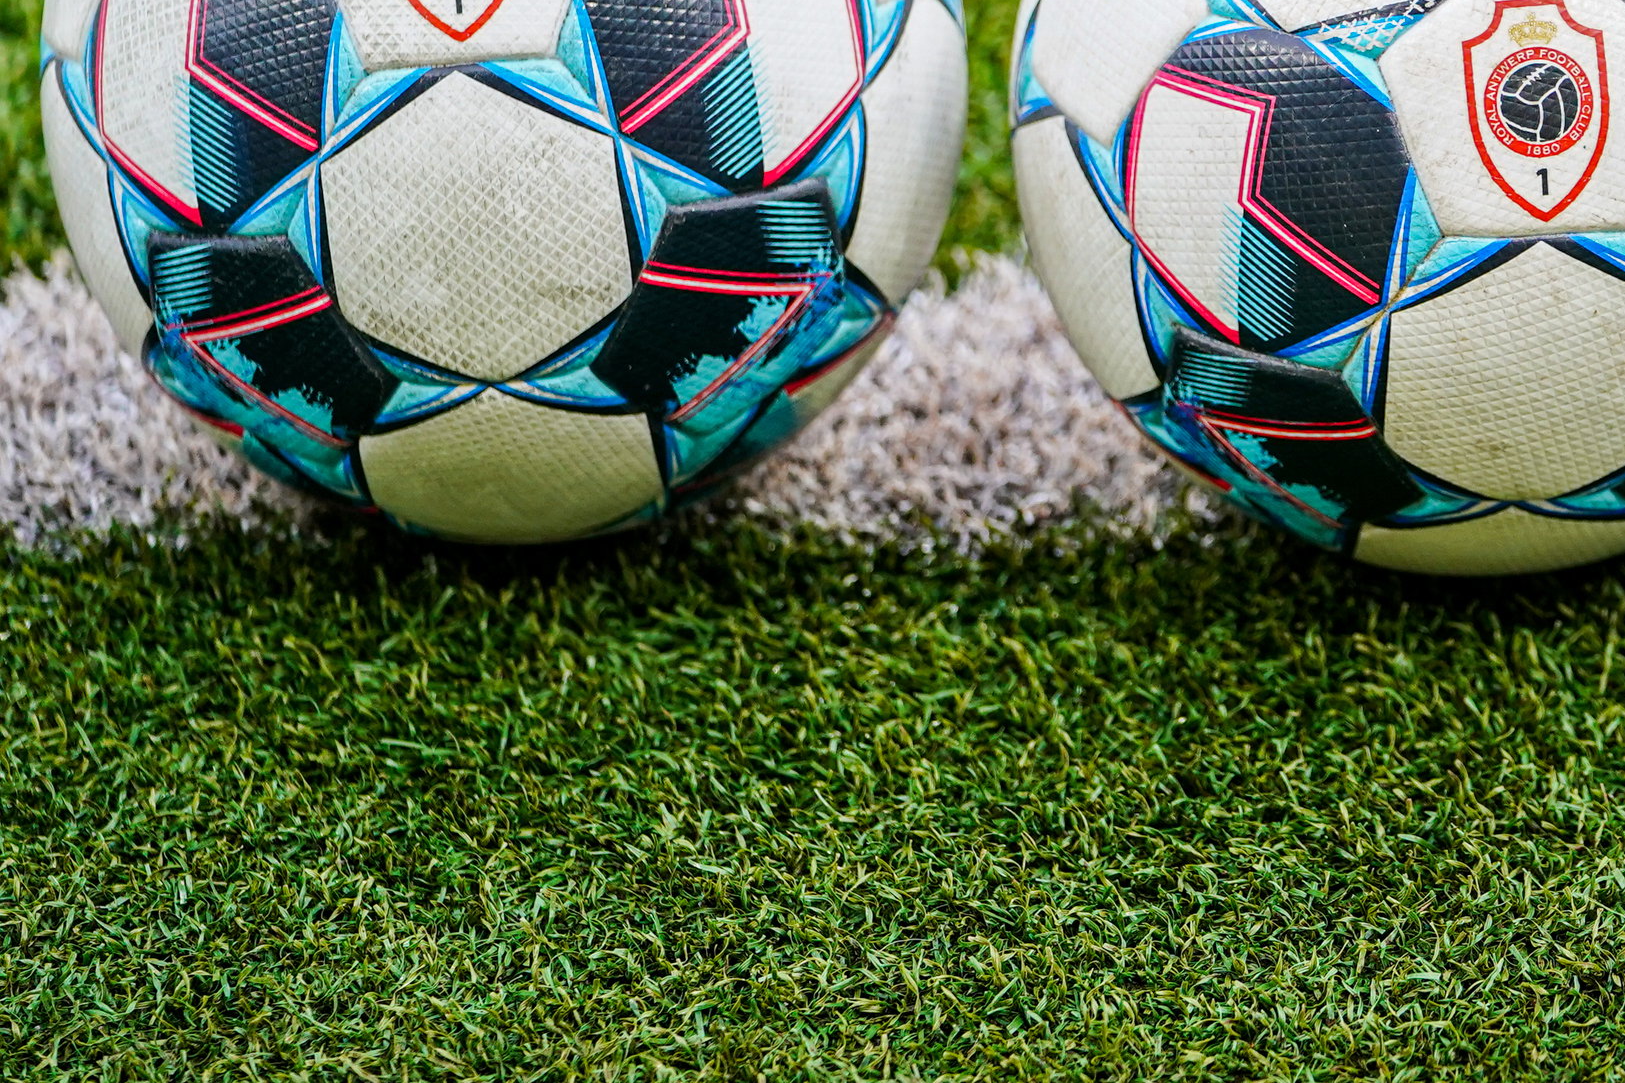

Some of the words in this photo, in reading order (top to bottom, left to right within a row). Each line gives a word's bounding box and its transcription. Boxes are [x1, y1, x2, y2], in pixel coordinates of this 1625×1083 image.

[1486, 49, 1535, 101] ANTWERP
[1538, 49, 1592, 101] FOOTBALL
[1486, 103, 1514, 146] ROYAL
[1569, 104, 1592, 141] CLUB
[1526, 142, 1561, 156] 1880
[1536, 168, 1549, 196] 1
